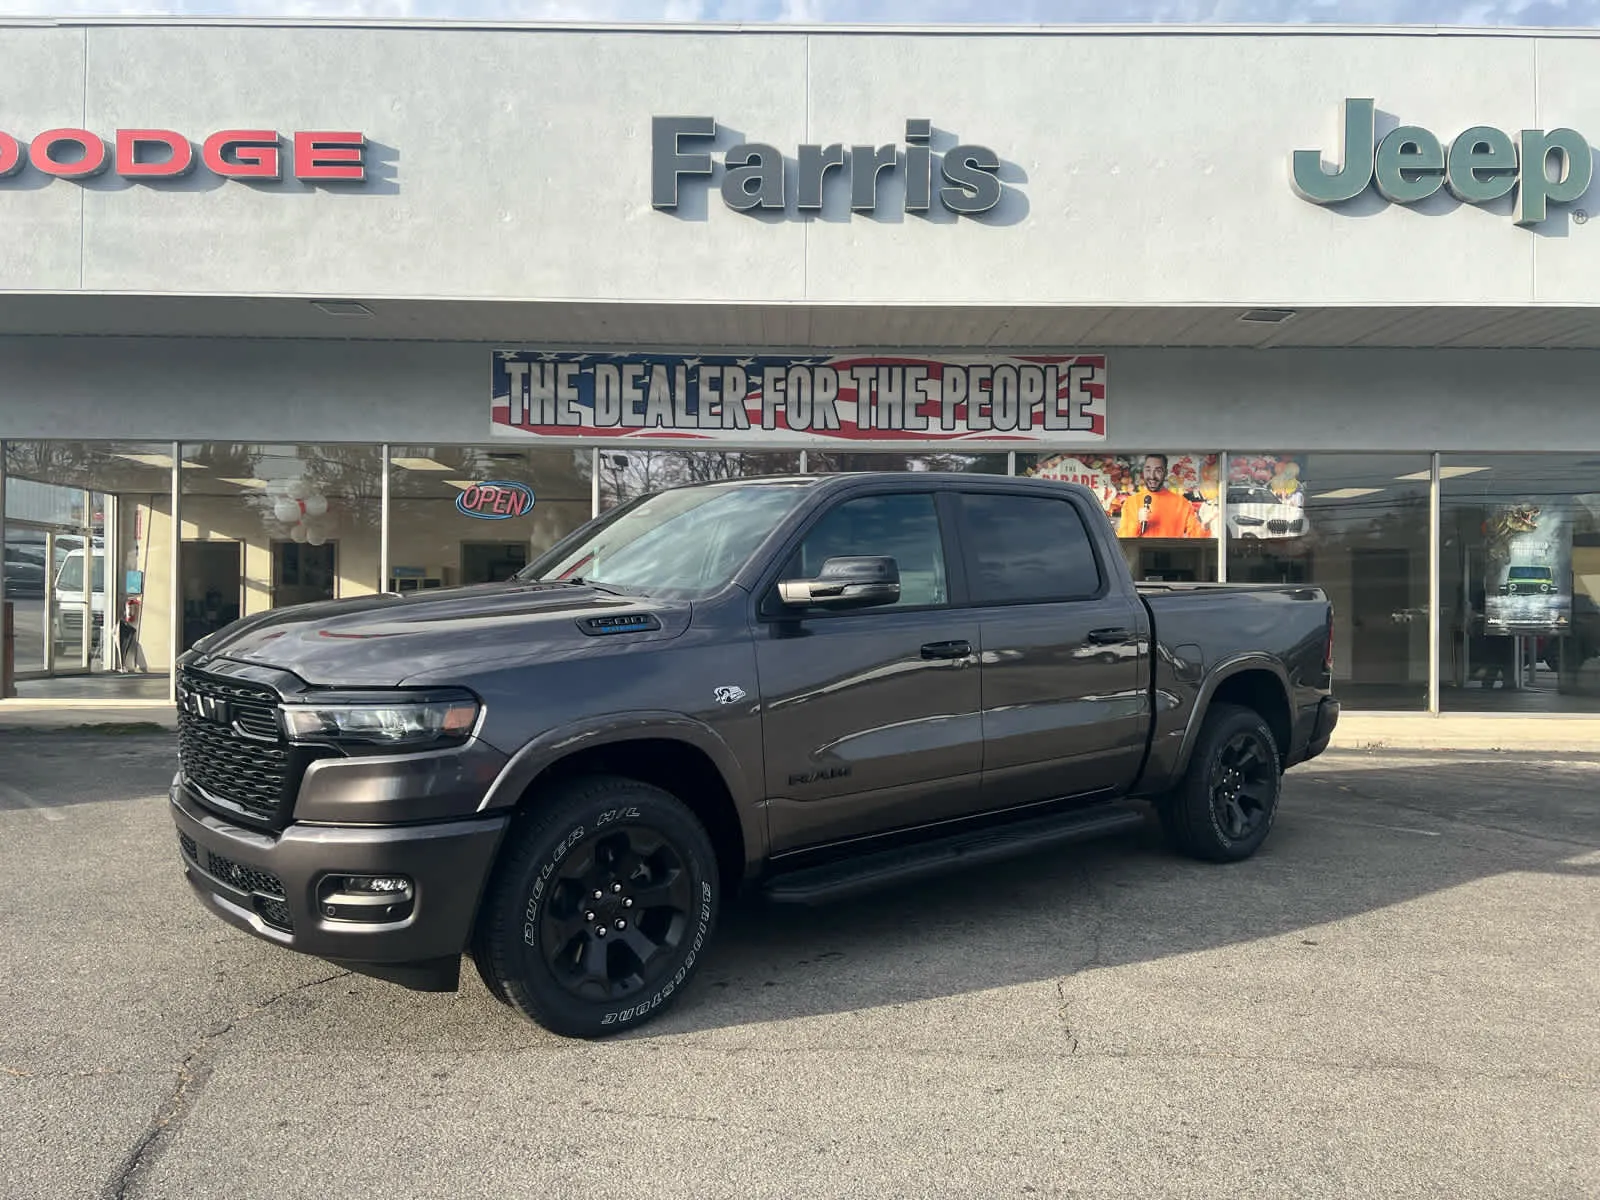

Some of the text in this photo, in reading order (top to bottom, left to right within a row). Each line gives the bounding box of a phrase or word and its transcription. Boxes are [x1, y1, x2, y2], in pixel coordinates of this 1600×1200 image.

[0, 127, 366, 182] ODGE
[651, 115, 1002, 214] Farris
[1290, 98, 1593, 226] Jeep
[504, 361, 1095, 432] THE DEALER FOR THE PEOPLE
[463, 484, 527, 516] OPEN
[590, 615, 647, 628] 1500
[524, 825, 585, 946] DUELER
[600, 880, 712, 1025] BRIDGESTONE
